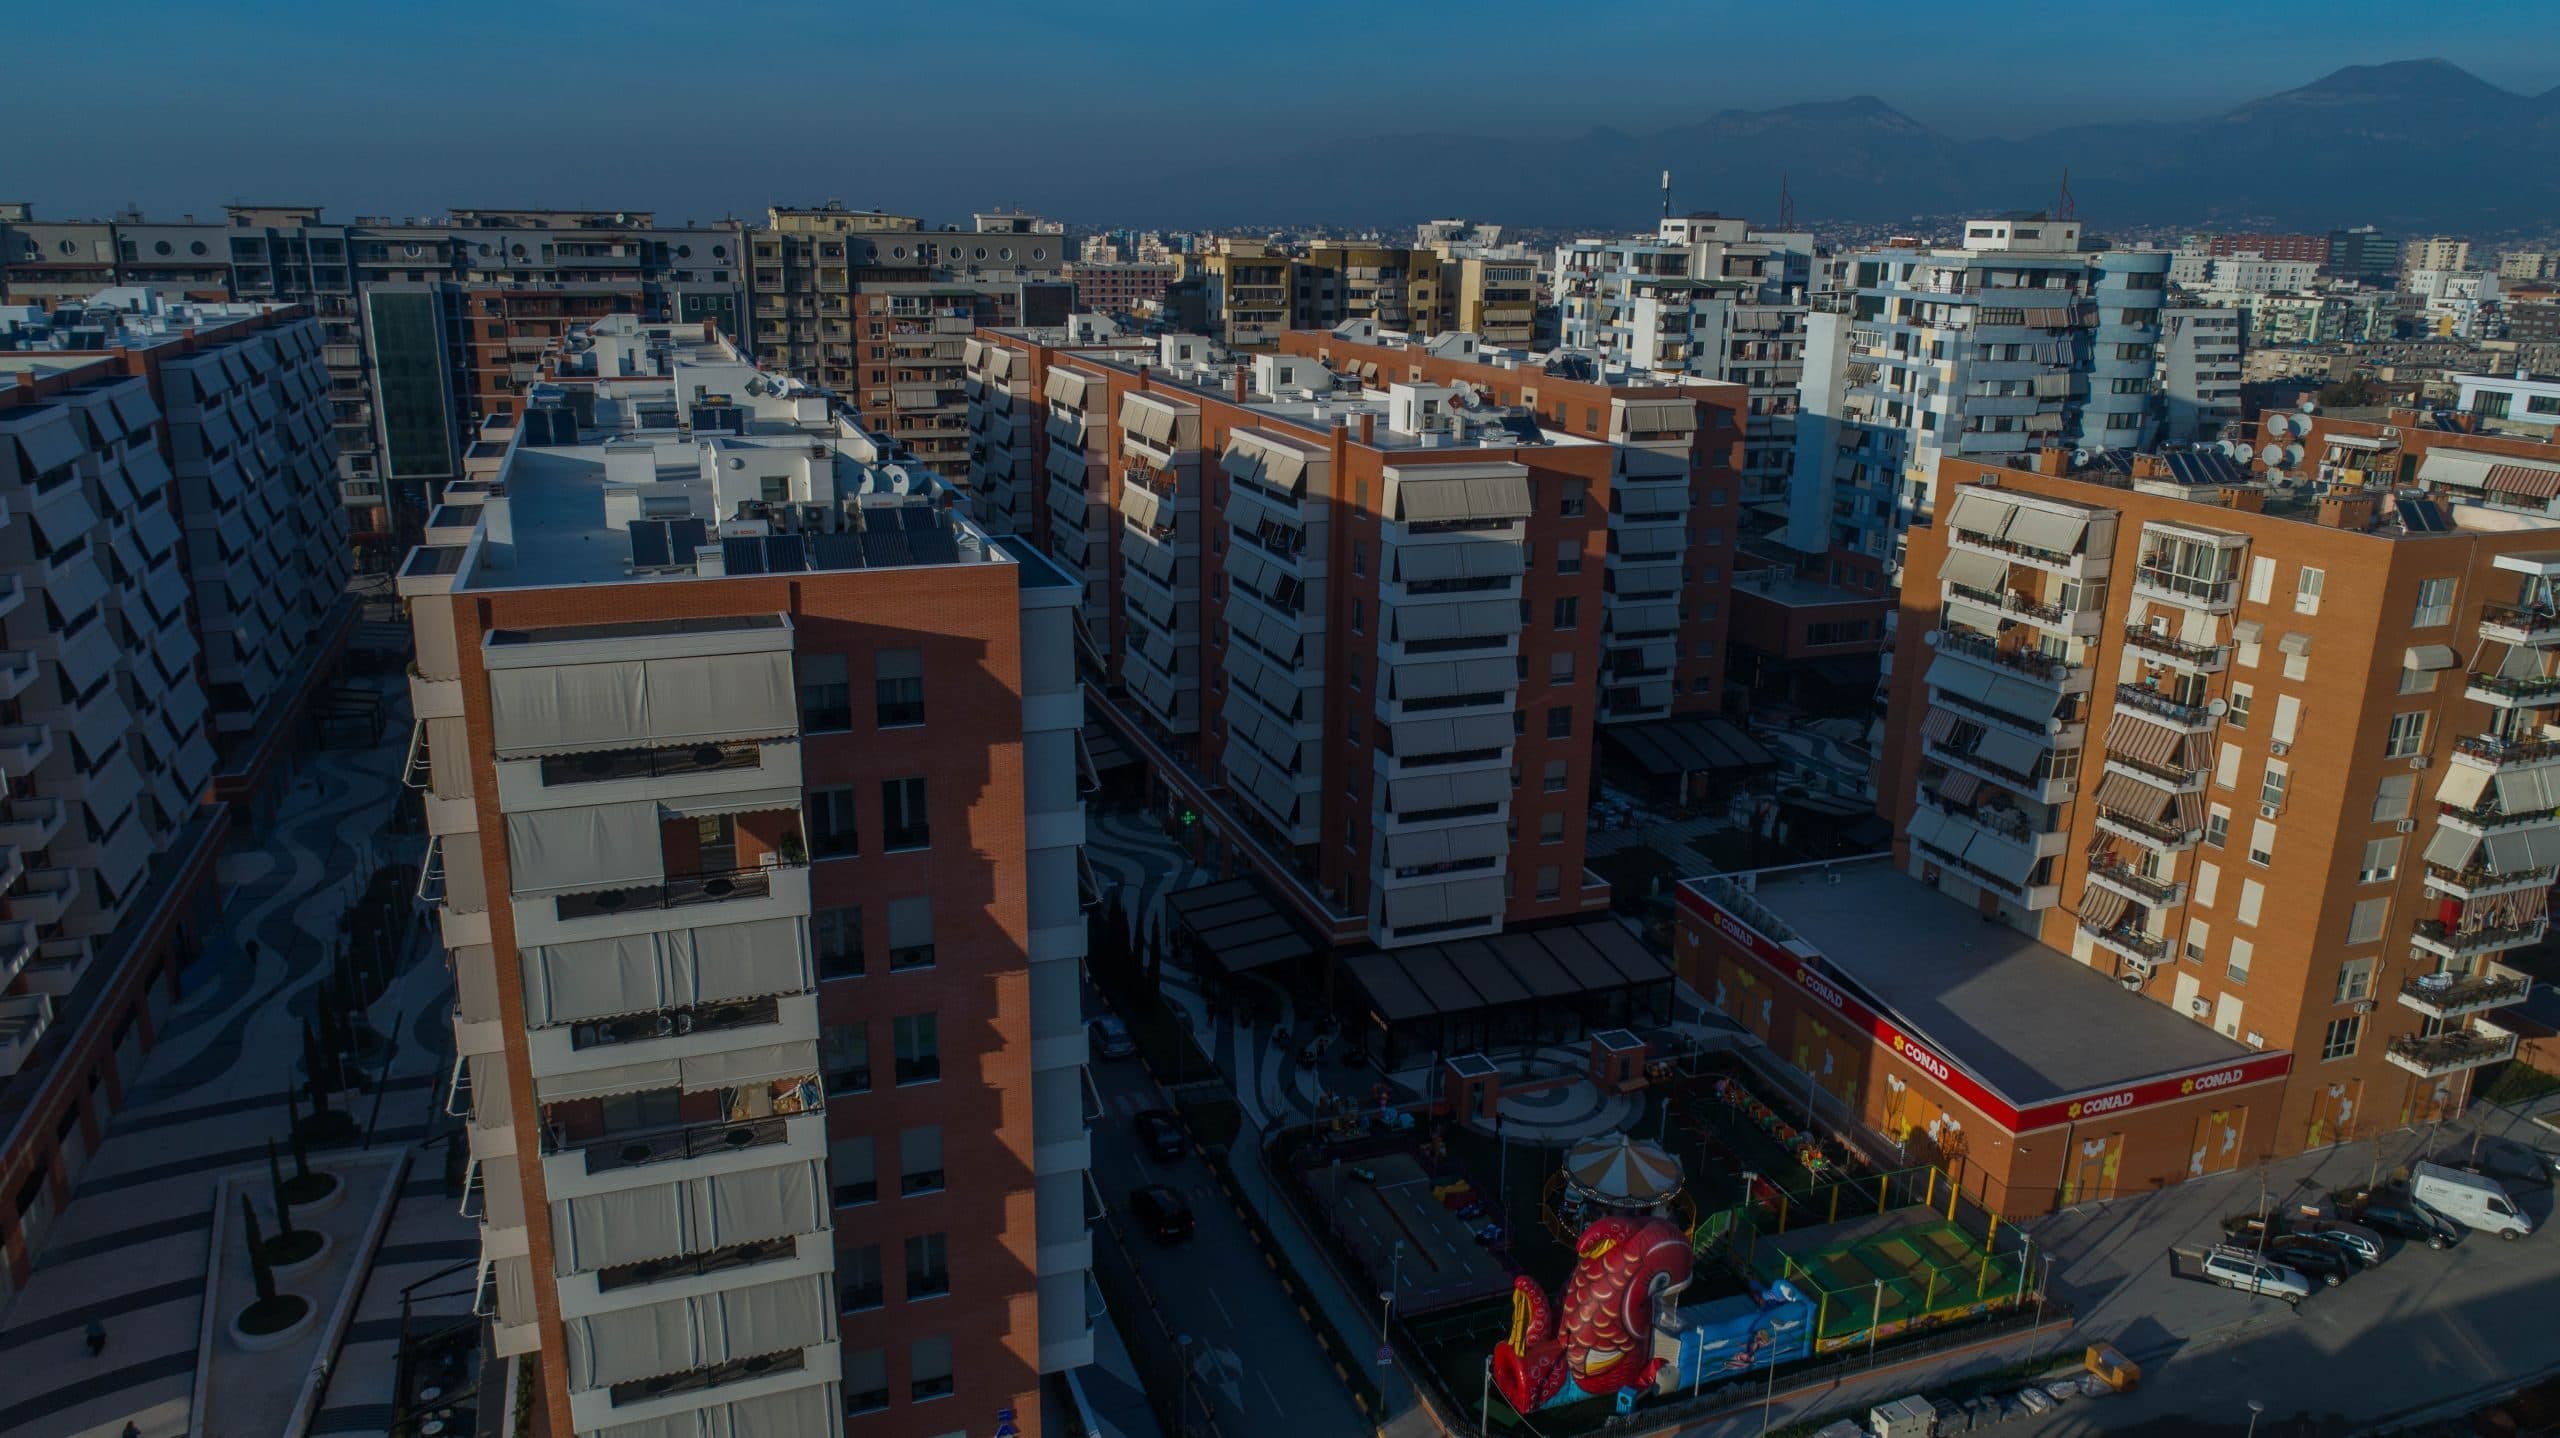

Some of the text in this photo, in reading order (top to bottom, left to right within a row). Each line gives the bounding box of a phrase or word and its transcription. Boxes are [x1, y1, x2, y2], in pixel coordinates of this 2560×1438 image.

[1721, 918, 1752, 946] CONAD
[1806, 976, 1843, 1008] CONAD
[1905, 1043, 1949, 1080] CONAD
[2195, 1069, 2243, 1091] CONAD
[2083, 1093, 2134, 1114] CONAD
